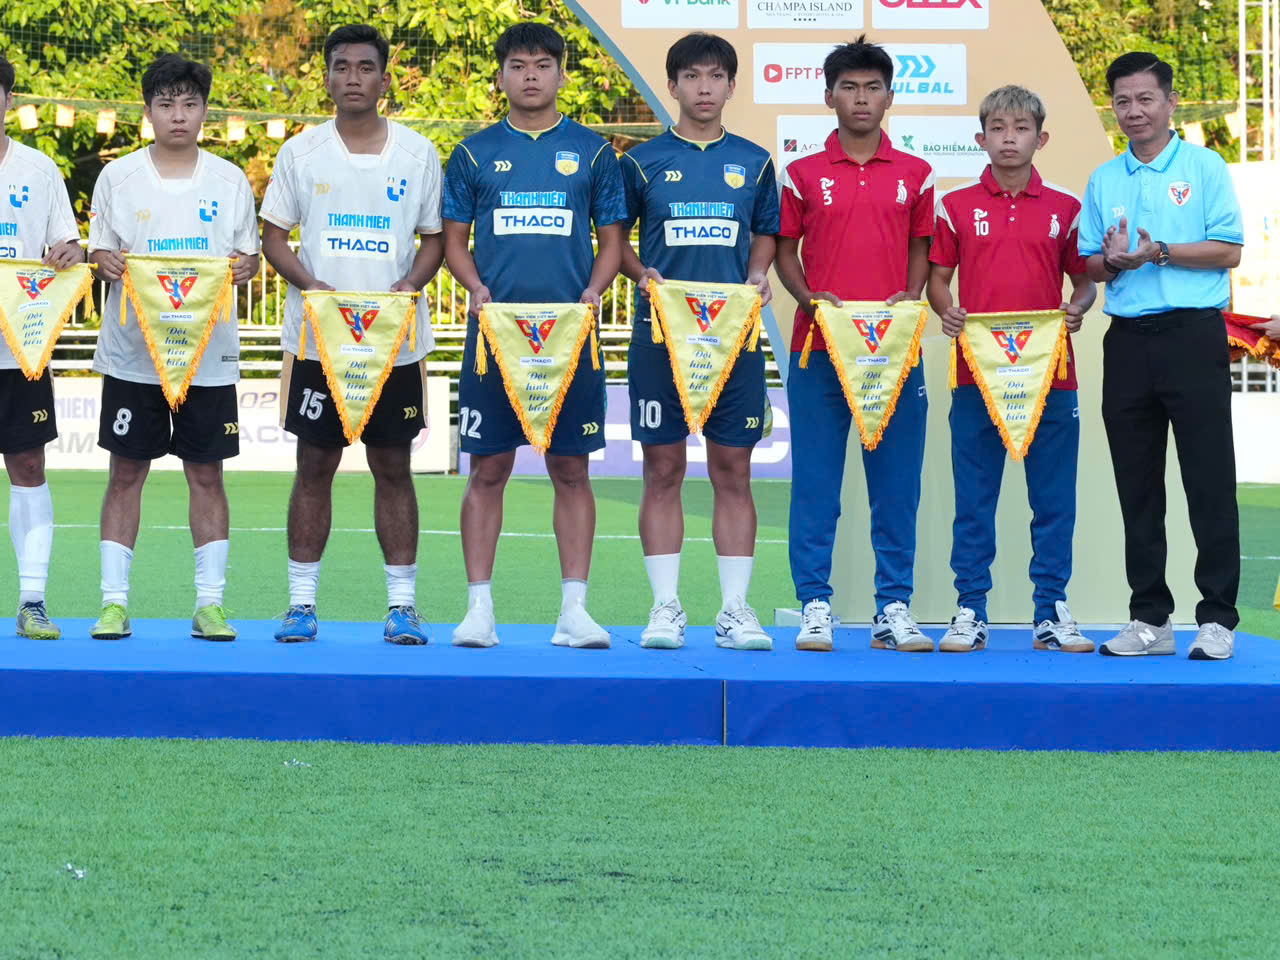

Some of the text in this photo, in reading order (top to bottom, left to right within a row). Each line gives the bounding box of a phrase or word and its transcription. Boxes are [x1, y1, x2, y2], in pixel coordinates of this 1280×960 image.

[757, 2, 852, 12] CHAMPA ISLAND
[785, 68, 811, 80] FPT
[893, 82, 954, 94] ULBAL
[500, 191, 538, 206] THANH
[823, 190, 832, 206] 3
[669, 202, 707, 217] THANH
[328, 213, 364, 228] THANH
[501, 215, 565, 228] THACO
[974, 220, 989, 236] 10
[672, 226, 731, 239] THACO
[148, 238, 184, 252] THANH
[327, 238, 389, 253] THACO
[240, 392, 278, 409] 02
[299, 388, 327, 421] 15
[638, 398, 662, 428] 10
[112, 408, 132, 436] 8
[460, 406, 482, 439] 12
[47, 427, 95, 453] AM
